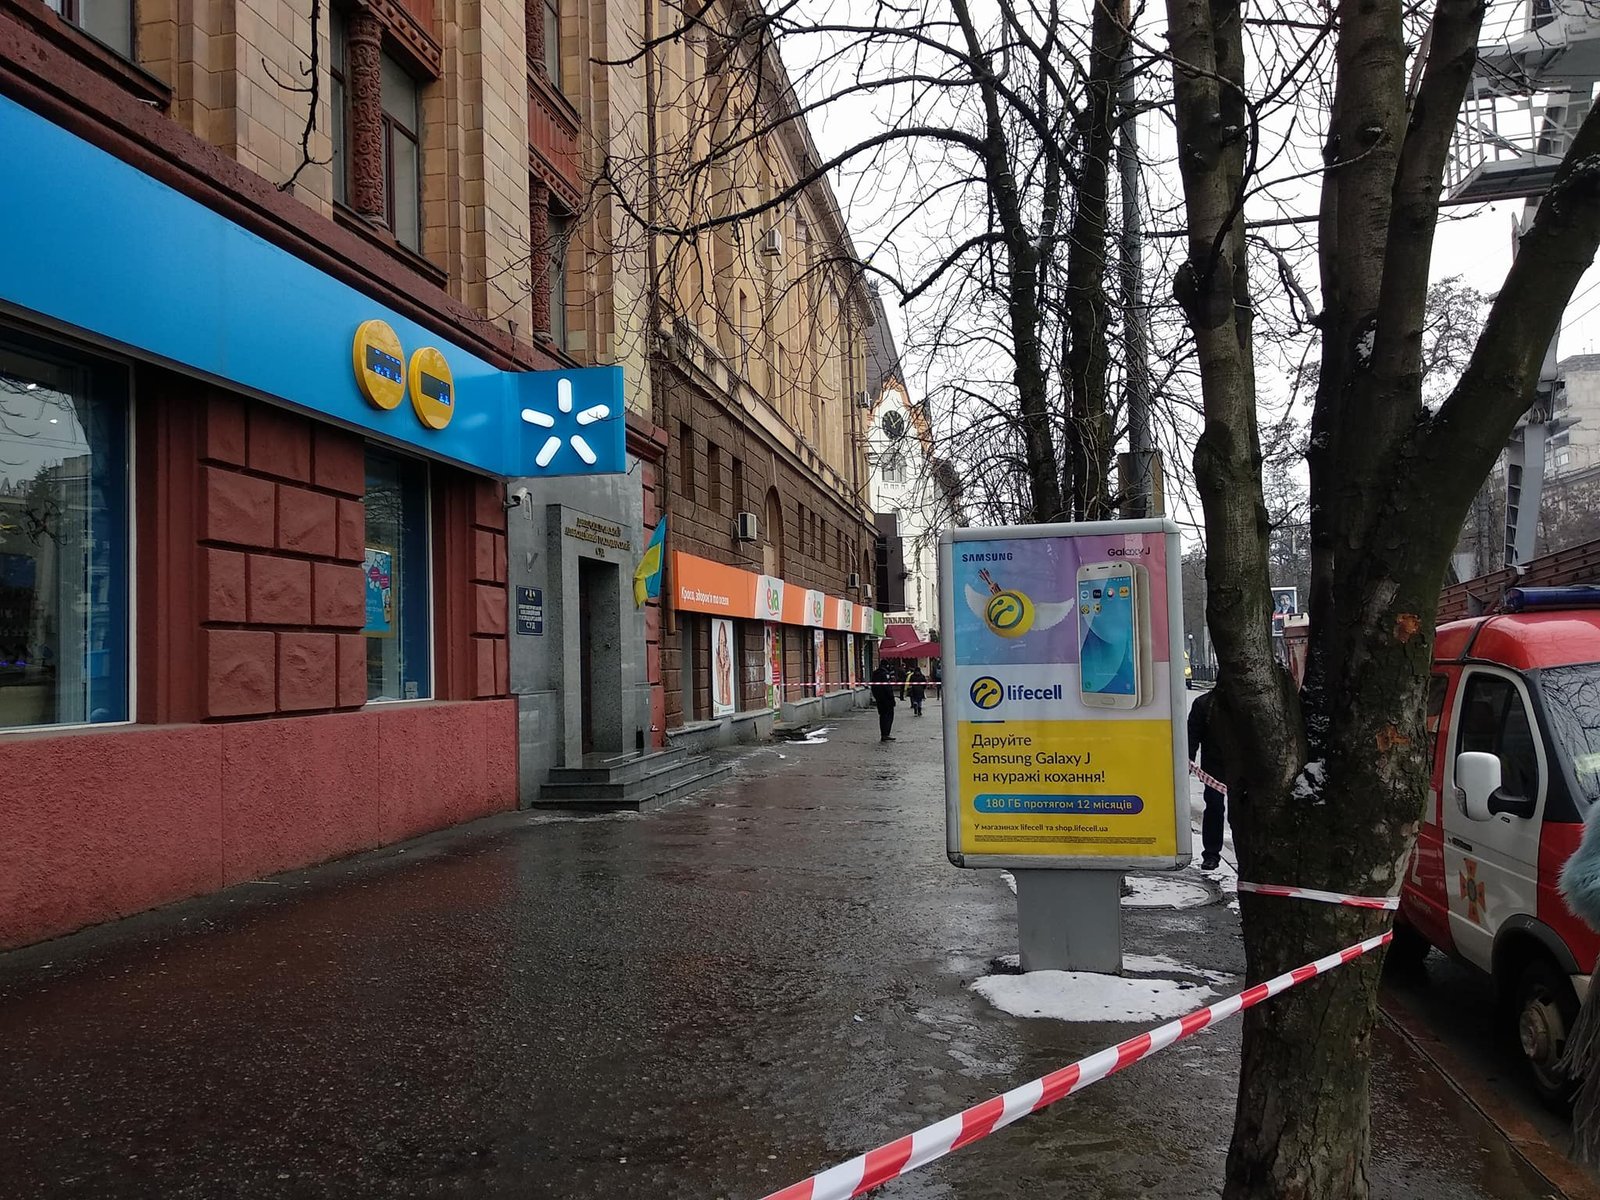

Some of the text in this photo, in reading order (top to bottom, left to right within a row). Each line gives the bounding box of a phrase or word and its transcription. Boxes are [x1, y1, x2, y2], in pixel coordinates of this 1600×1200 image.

[962, 552, 1013, 563] SAMSUNG
[1107, 546, 1151, 558] Galaxy J
[1007, 684, 1062, 701] lifecell
[971, 734, 1032, 748] Даруйте
[972, 752, 1091, 766] Samsung Galaxy J
[973, 770, 1106, 784] на куражі кохання!
[986, 798, 1133, 811] 180 ГБ протягом 12 місяців
[1020, 823, 1044, 832] lifecell
[1055, 825, 1108, 833] shop.lifecell.ua
